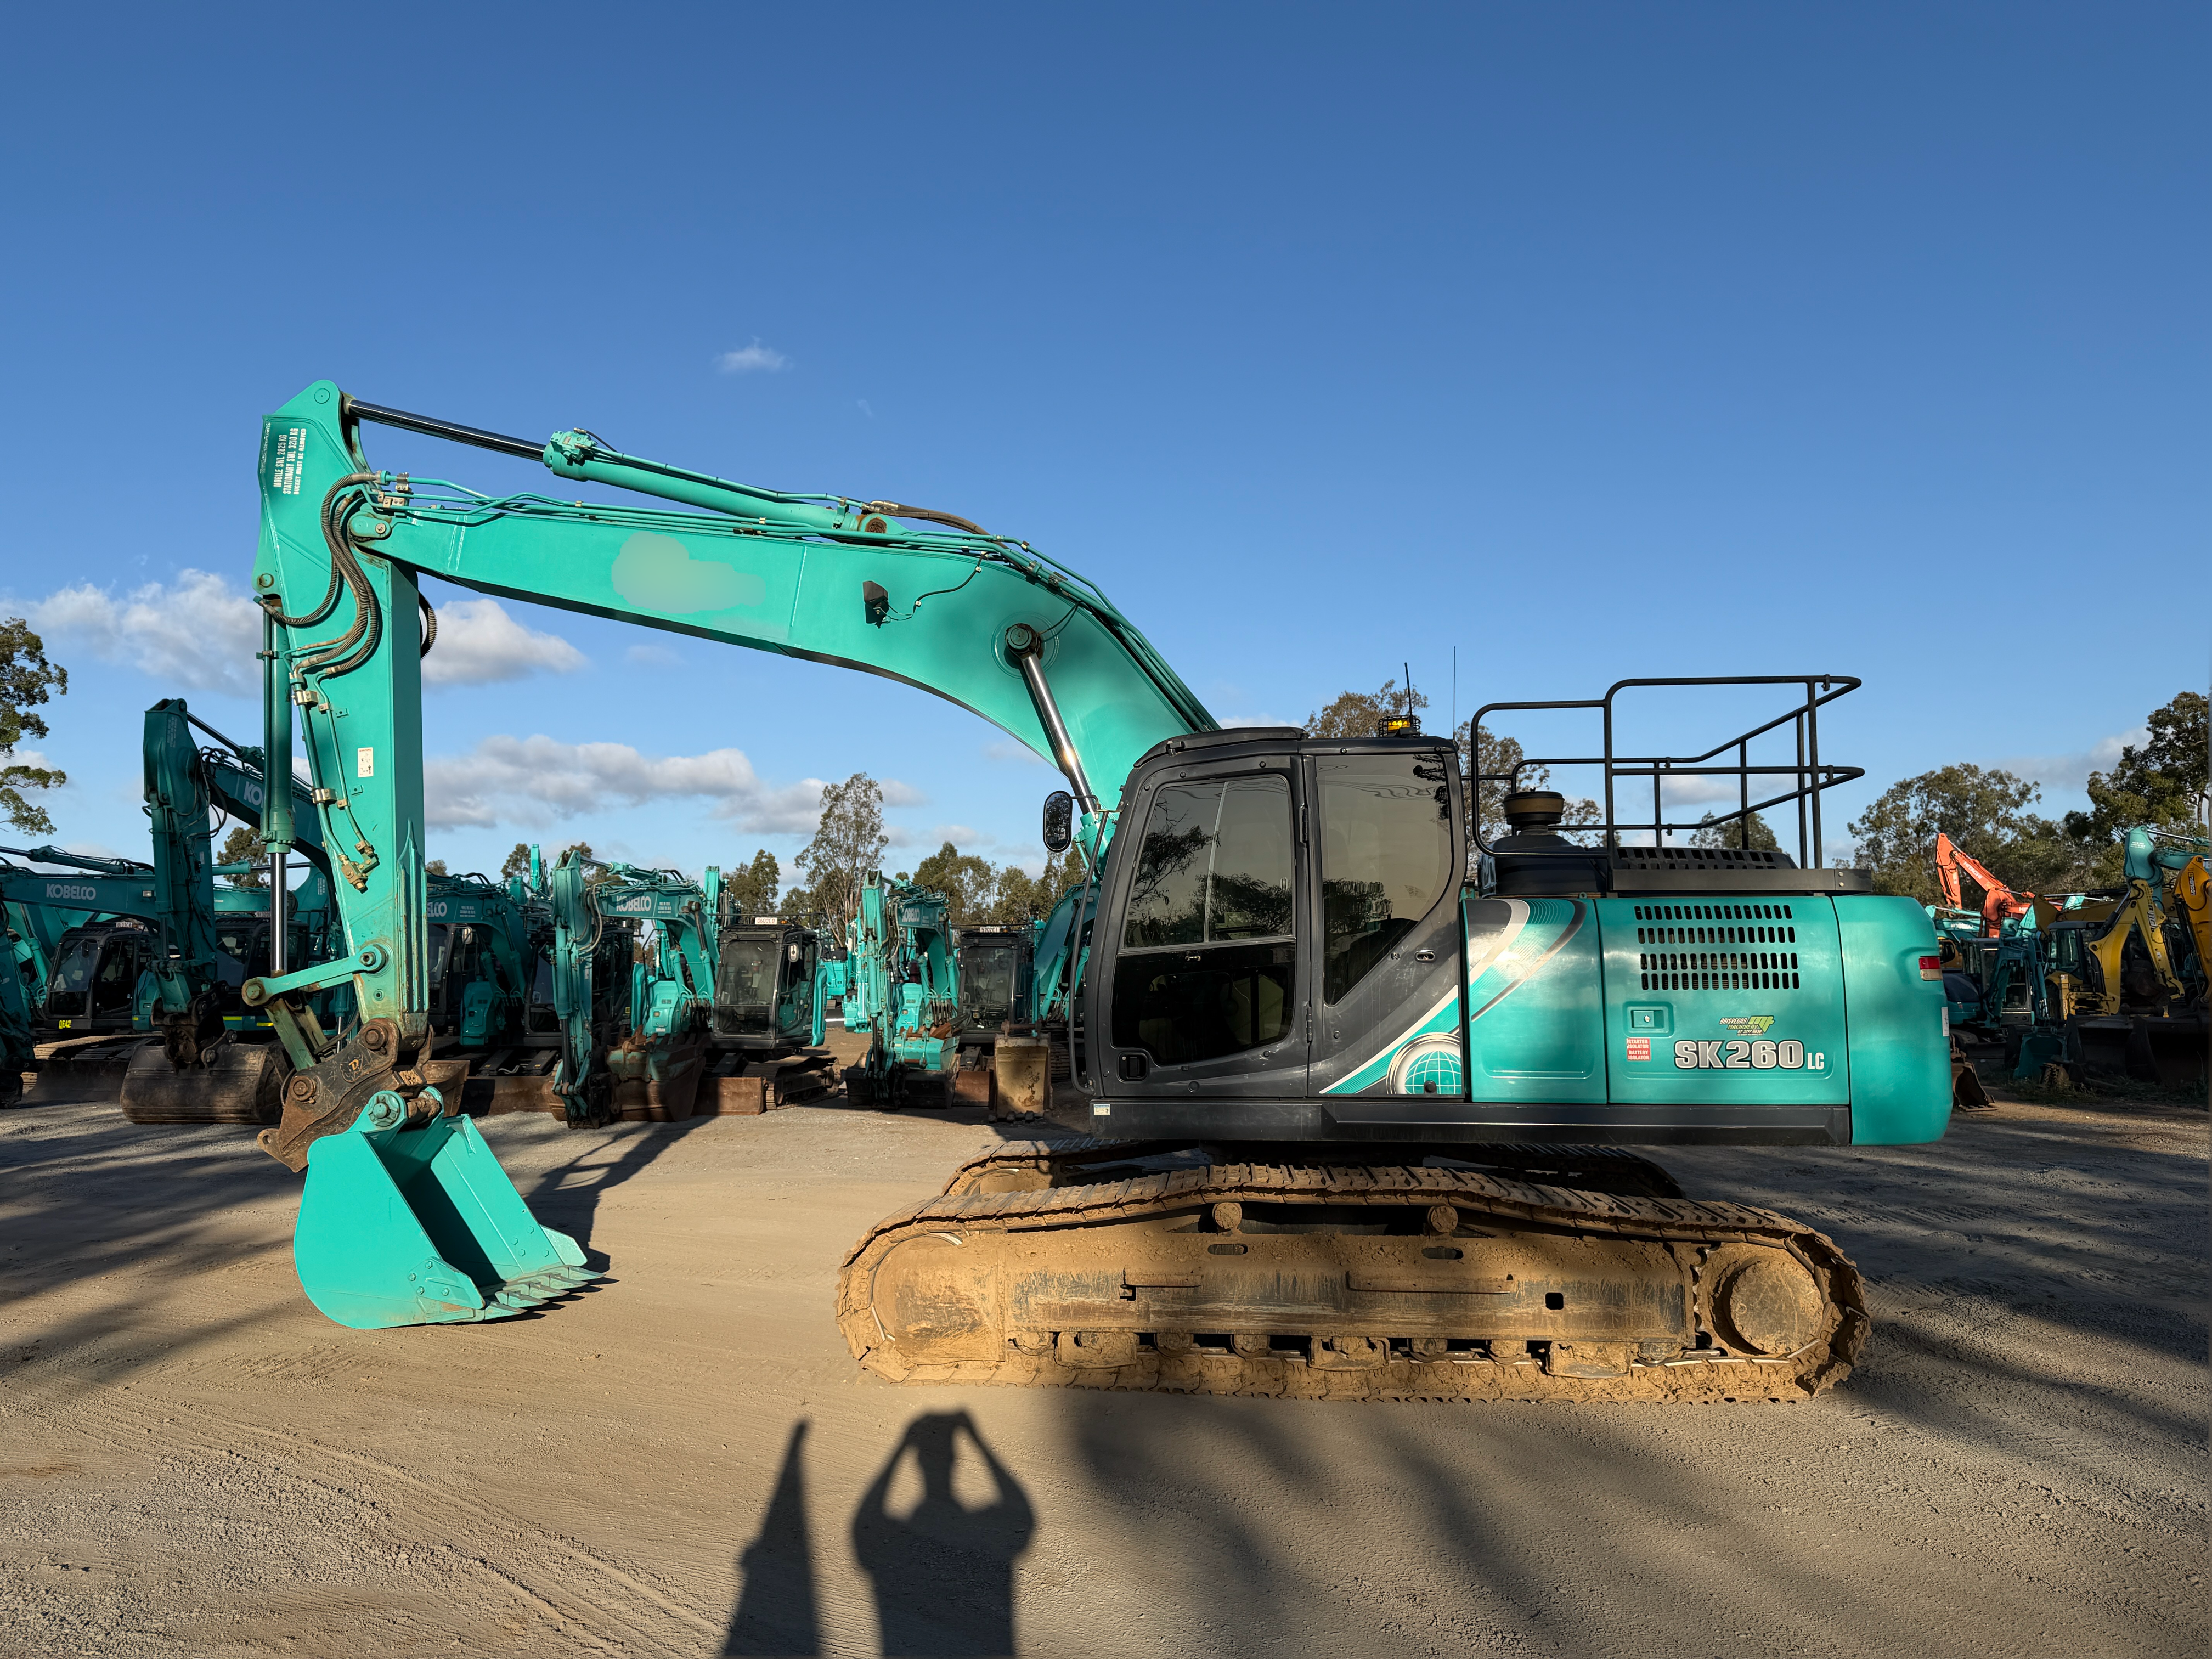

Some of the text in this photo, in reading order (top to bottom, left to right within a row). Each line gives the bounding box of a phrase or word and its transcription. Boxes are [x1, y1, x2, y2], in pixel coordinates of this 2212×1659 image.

[277, 442, 286, 455] 2825
[288, 437, 297, 449] 3210
[275, 456, 285, 467] SWL
[286, 451, 296, 462] SWL
[273, 469, 283, 487] MOBILE
[283, 463, 294, 494] STATIONARY
[1963, 861, 1982, 879] HITACHI
[46, 883, 96, 900] KOBELCO
[617, 895, 651, 912] KOBELCO
[1674, 1040, 1825, 1070] SK260 LC
